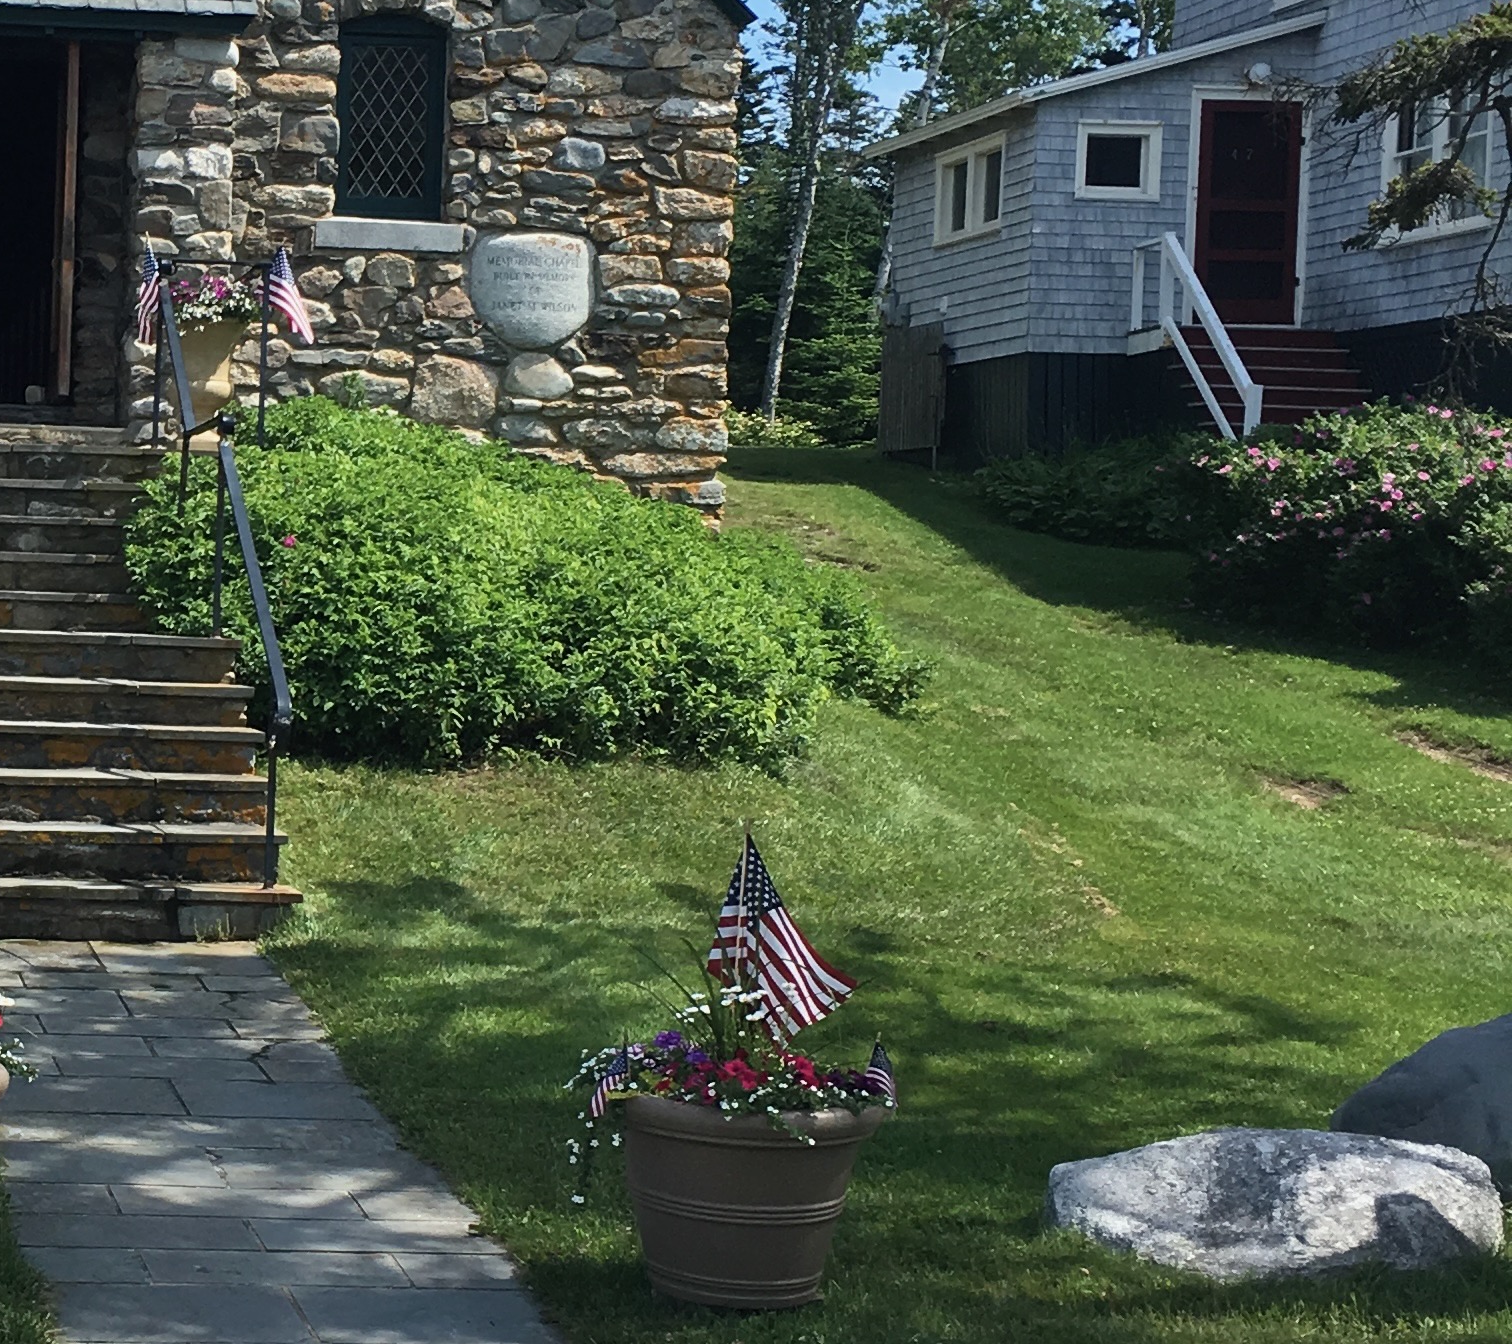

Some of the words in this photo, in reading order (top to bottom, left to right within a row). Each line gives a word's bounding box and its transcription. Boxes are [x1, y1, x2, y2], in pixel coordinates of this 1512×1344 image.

[487, 255, 542, 267] MEMORIAL
[544, 256, 580, 269] CHAPEL
[493, 271, 520, 281] BUILT
[491, 300, 524, 312] JANET
[541, 301, 577, 313] WILSON
